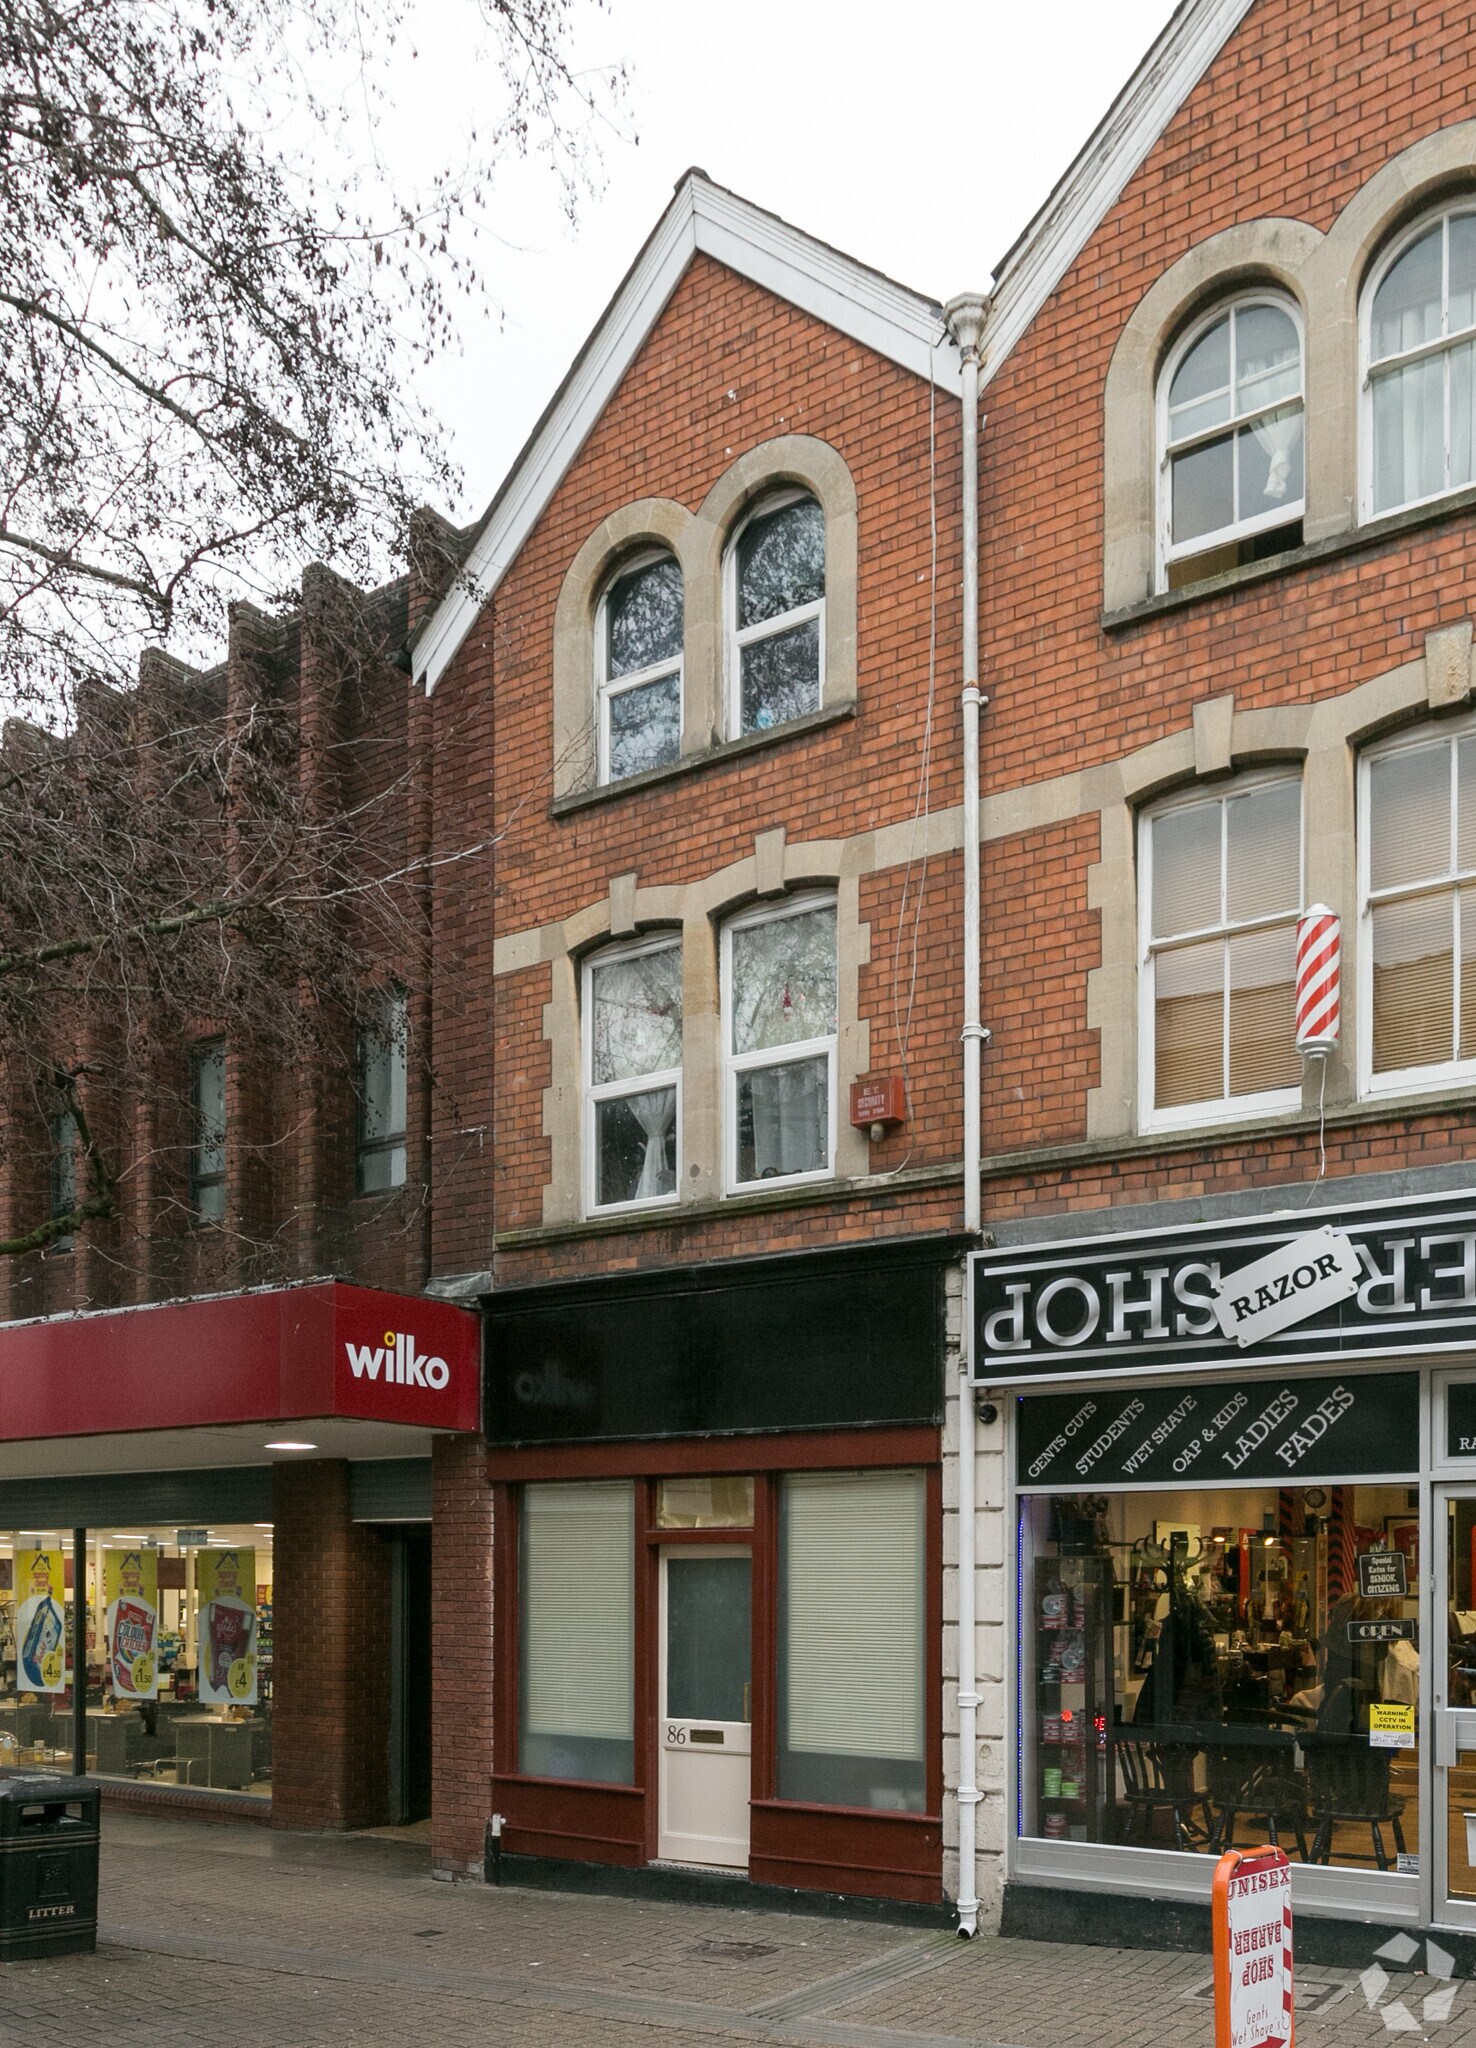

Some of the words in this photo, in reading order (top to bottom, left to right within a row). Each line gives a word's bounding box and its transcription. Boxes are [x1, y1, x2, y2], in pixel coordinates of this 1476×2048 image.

[1229, 1253, 1342, 1323] RAZOR
[984, 1262, 1221, 1350] SHOP
[344, 1331, 450, 1390] wilko
[1028, 1434, 1067, 1478] GENTS
[1064, 1401, 1097, 1437] CUTS
[1075, 1397, 1145, 1476] STUDENTS
[1121, 1440, 1154, 1475] WET
[1151, 1394, 1198, 1445] SHAVE
[1172, 1439, 1202, 1472] OAP
[1201, 1428, 1217, 1442] &
[1211, 1391, 1249, 1431] KIDS
[1221, 1388, 1299, 1470] LADIES
[1275, 1384, 1355, 1468] FADES
[1369, 1574, 1397, 1583] SENIOR
[1386, 1565, 1397, 1573] for
[1367, 1584, 1400, 1594] CITIZENS
[1359, 1624, 1403, 1637] OPEN
[667, 1725, 686, 1745] 86
[1228, 1866, 1291, 1901] UNISEX
[28, 1905, 75, 1919] LITTER
[1233, 1920, 1282, 1956] BARBER
[1242, 1954, 1274, 1987] SHOP
[1246, 2004, 1269, 2025] Gents
[1231, 2027, 1247, 2047] Wet
